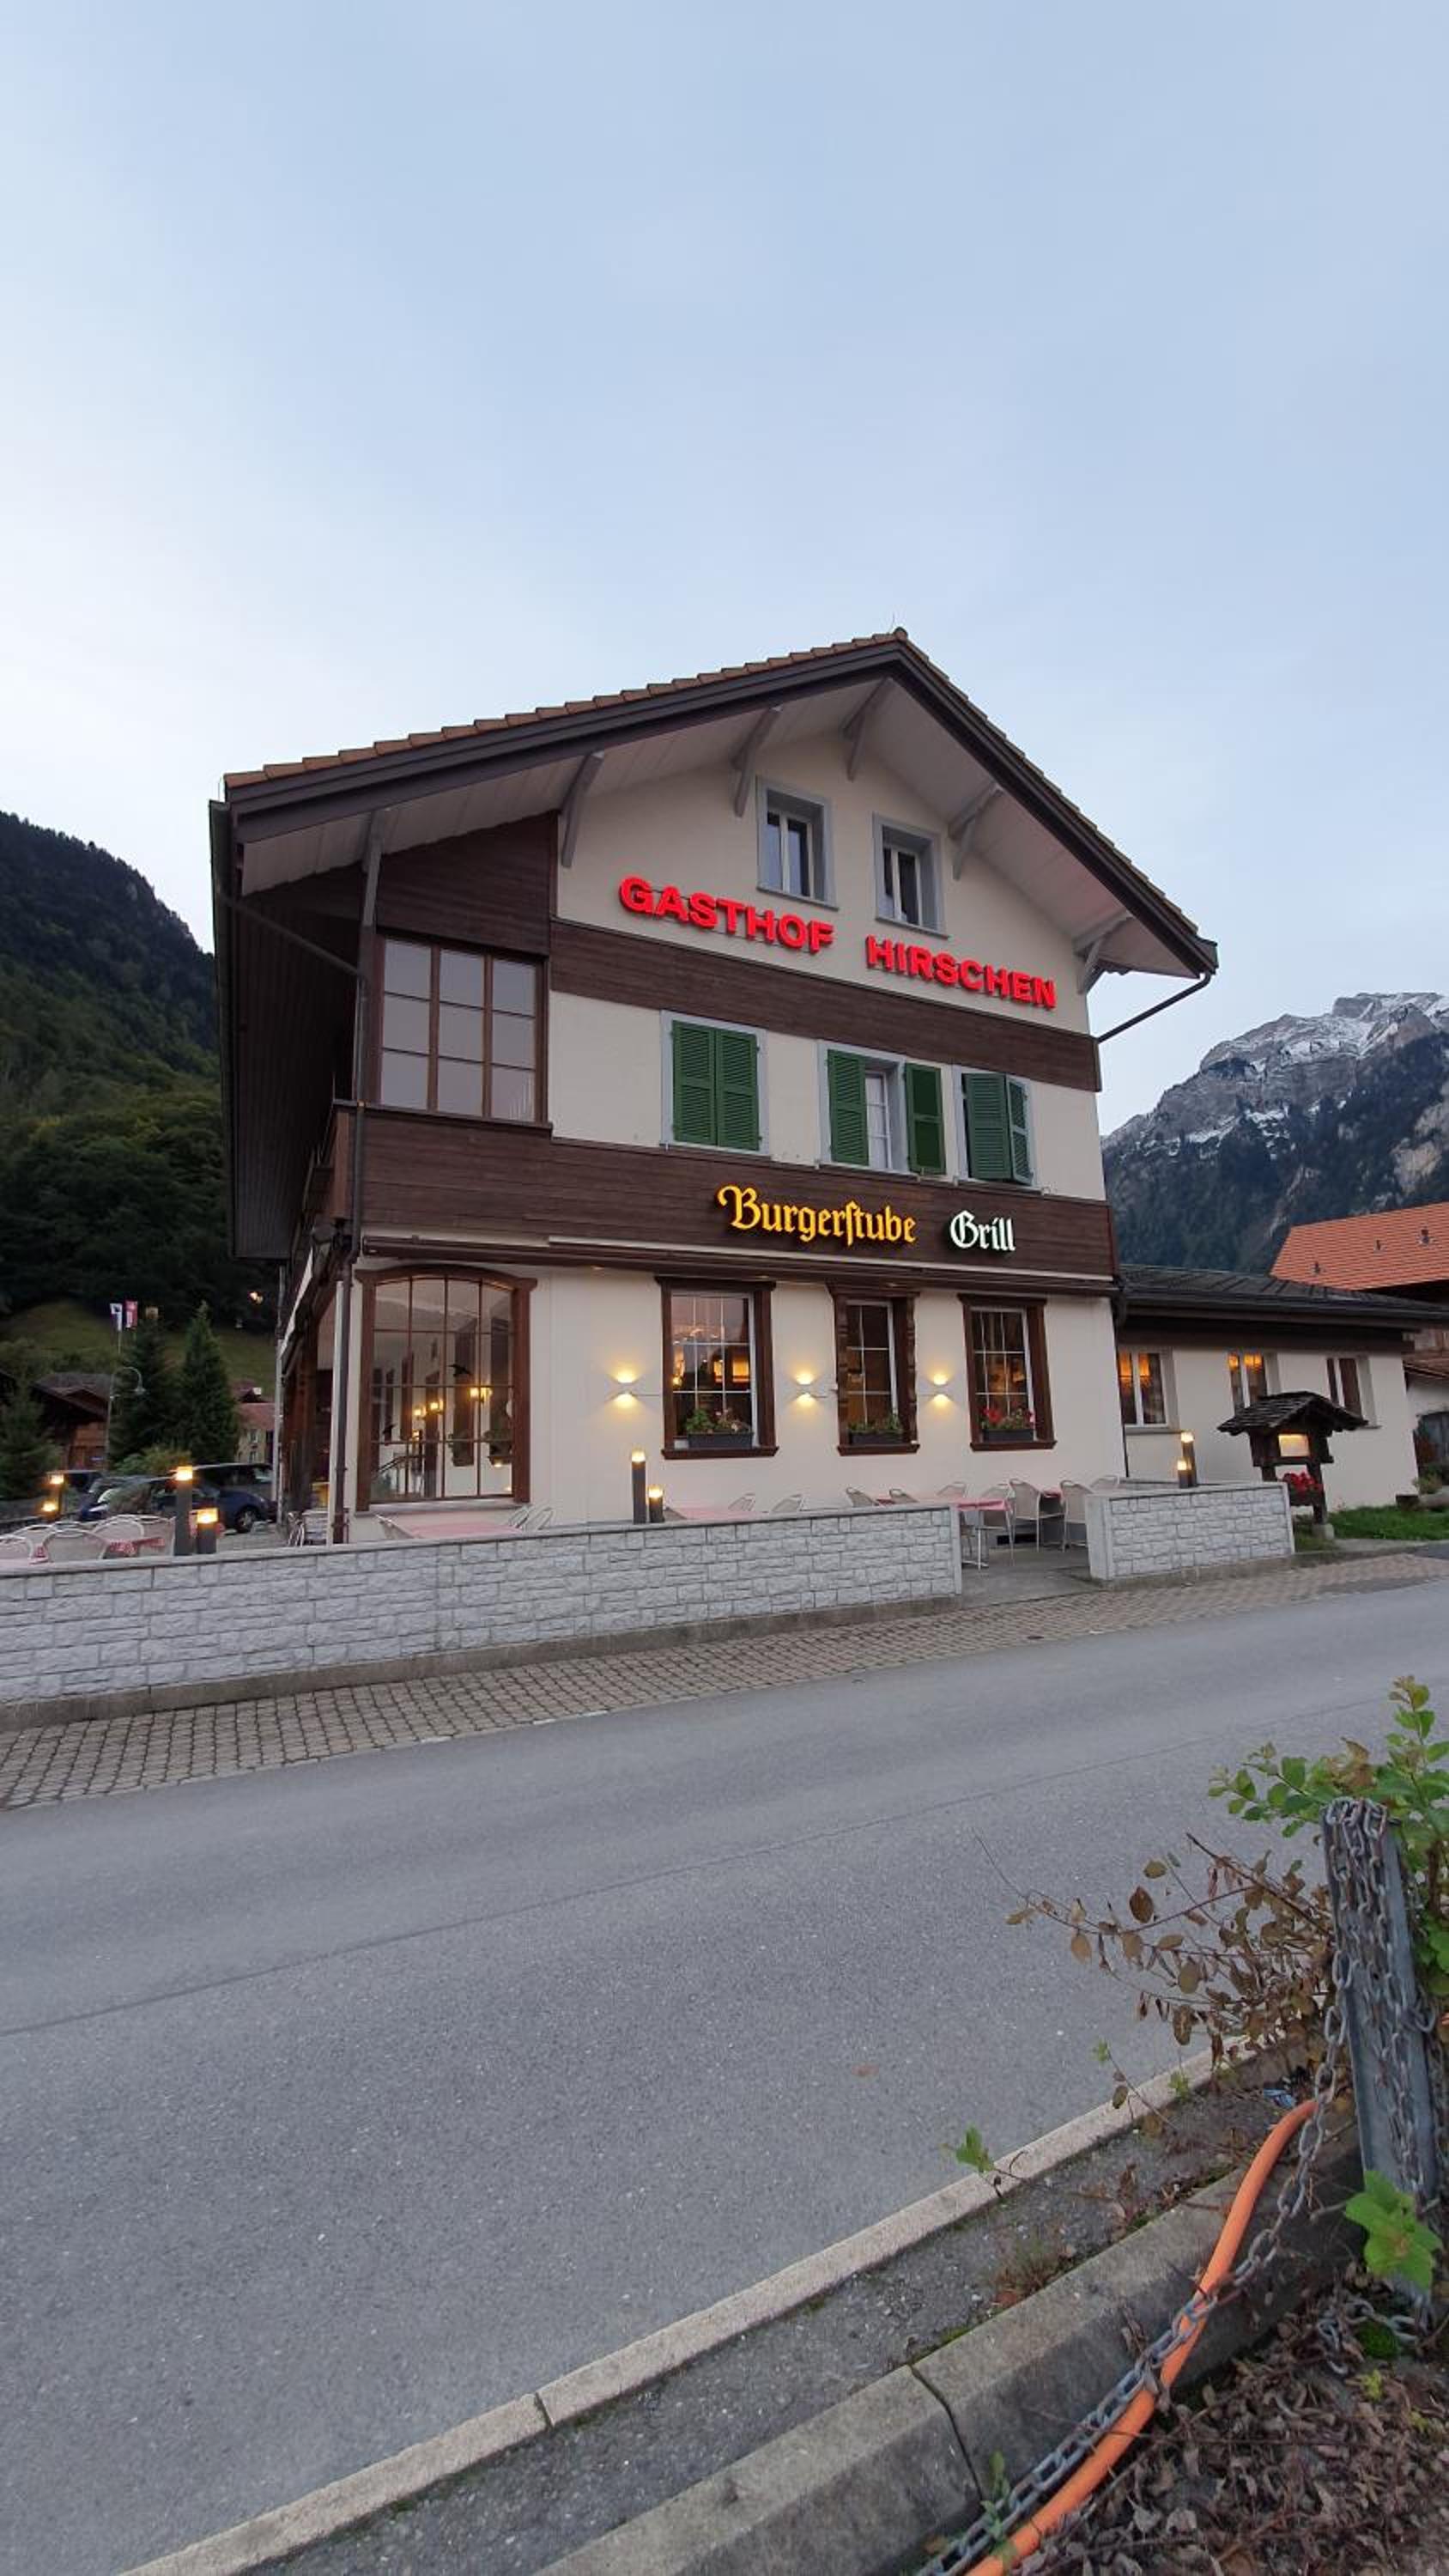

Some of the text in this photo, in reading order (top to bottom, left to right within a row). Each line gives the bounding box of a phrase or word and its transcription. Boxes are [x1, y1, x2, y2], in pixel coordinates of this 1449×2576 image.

[619, 875, 1057, 1008] GASTHOF HIRSCHEN
[950, 1210, 1016, 1251] Grill
